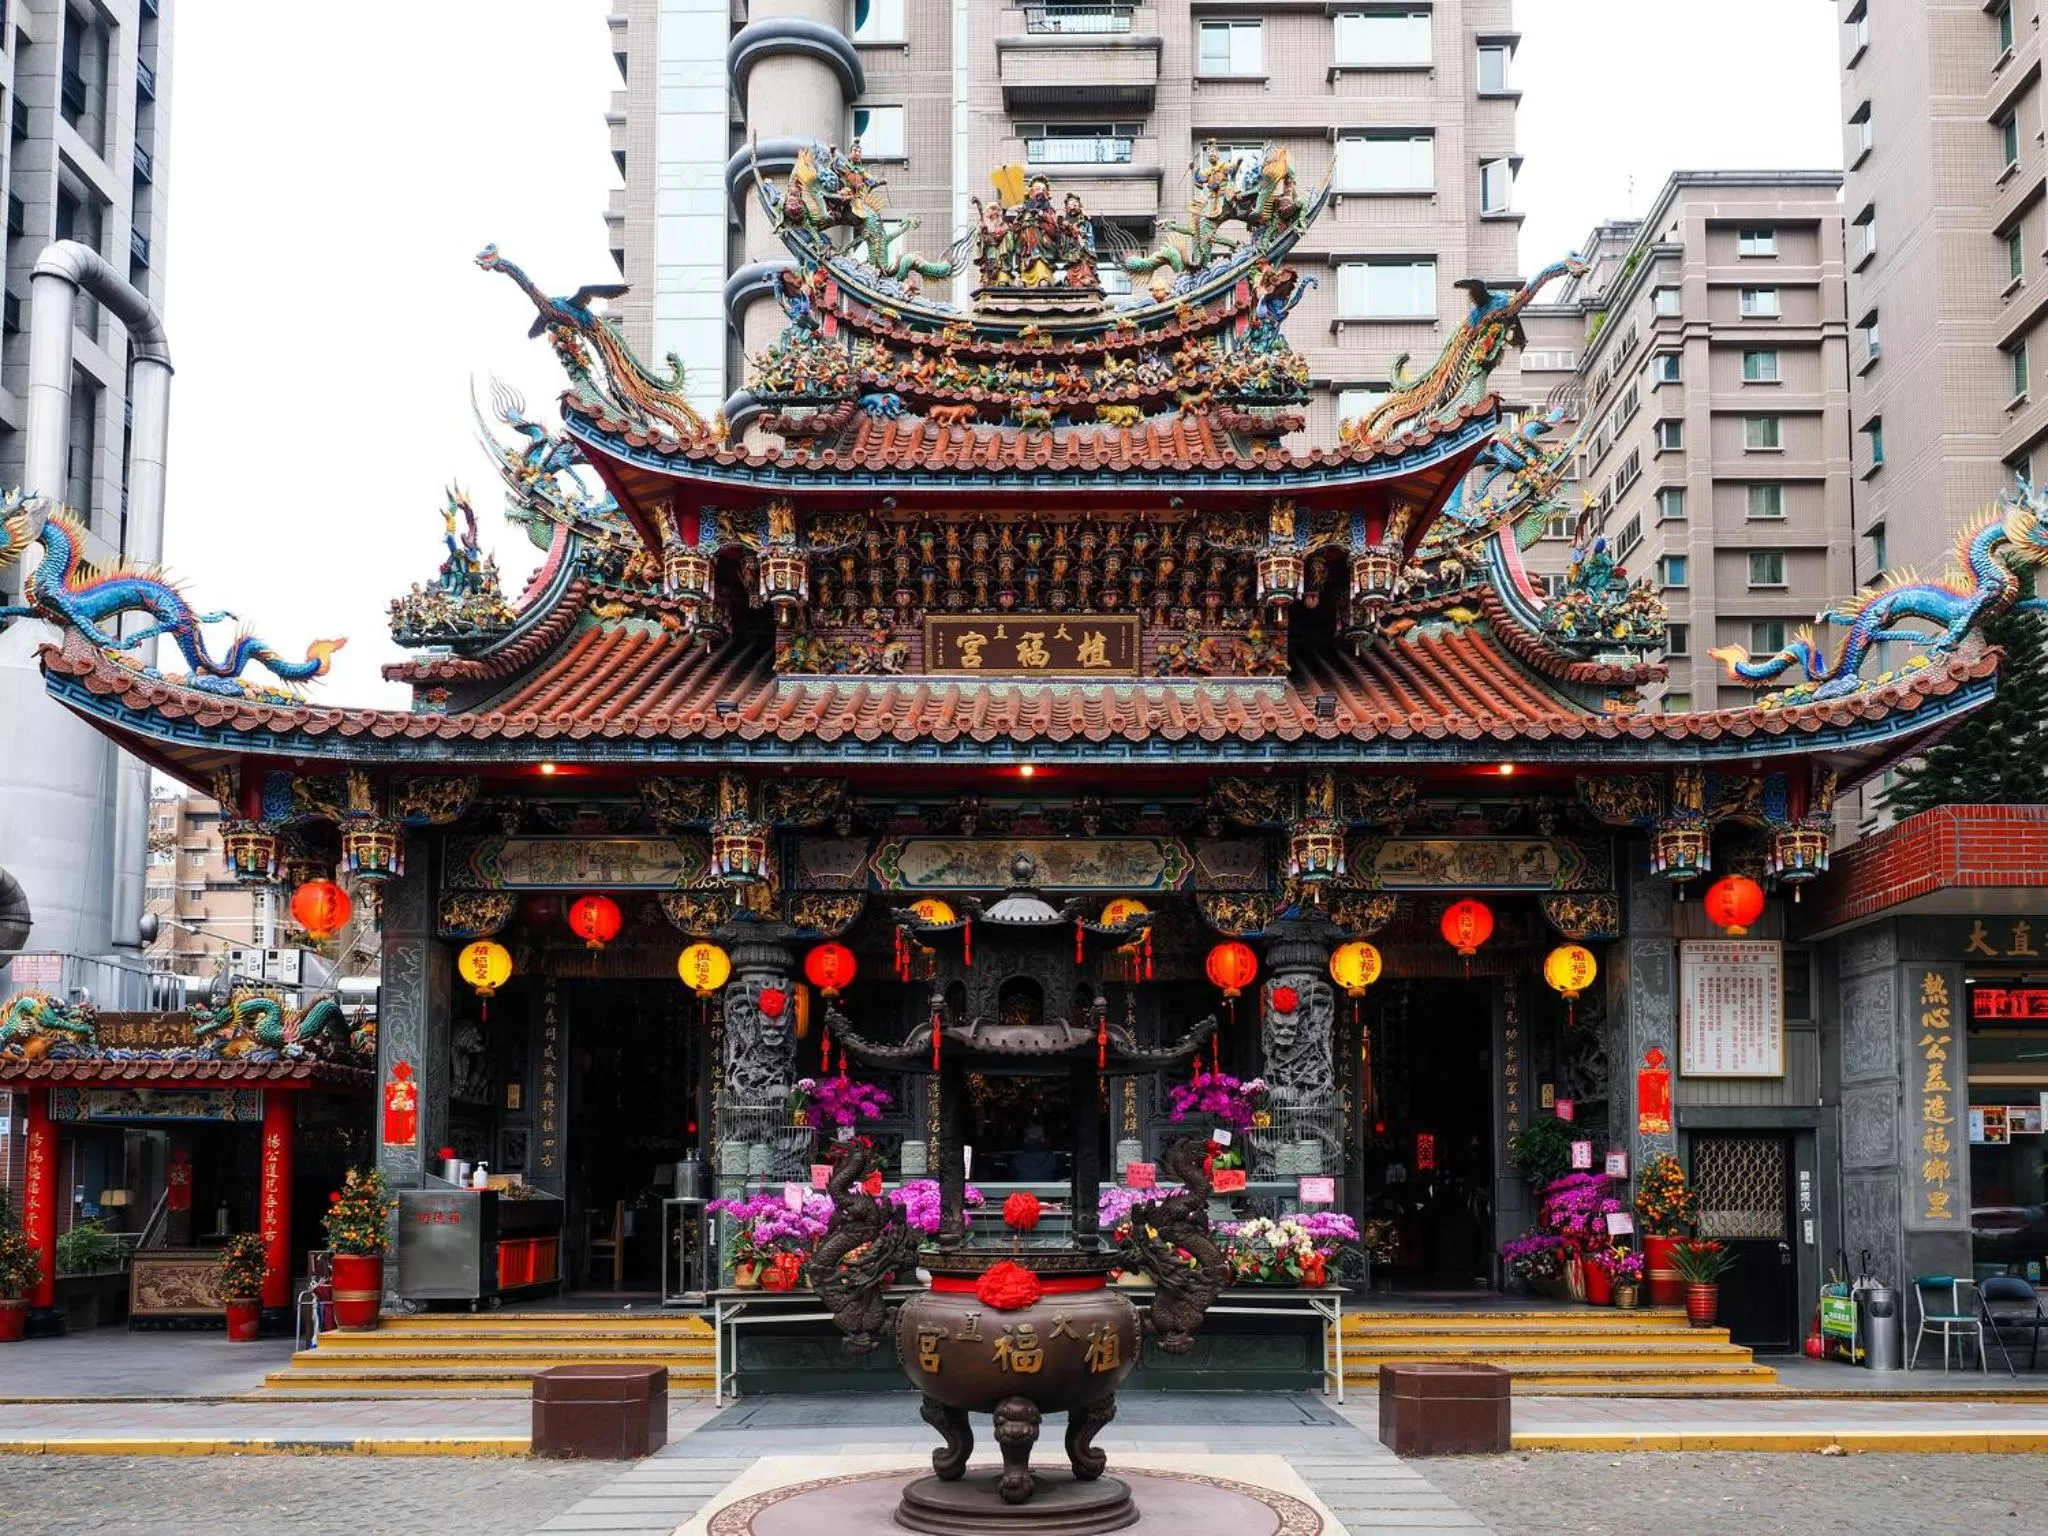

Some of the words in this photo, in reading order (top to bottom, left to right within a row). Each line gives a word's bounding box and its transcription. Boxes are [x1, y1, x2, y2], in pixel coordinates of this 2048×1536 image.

[993, 623, 1073, 640] 大直
[956, 630, 1112, 669] 植福宮
[1966, 920, 2048, 956] 大直
[474, 945, 488, 979] 植福宮
[694, 949, 710, 984] 植福宮
[1360, 948, 1375, 982] 植福宮
[1571, 951, 1585, 985] 植福宮
[1918, 971, 1954, 1219] 熱心公益造福鄉里
[917, 1320, 1121, 1375] 植福宮
